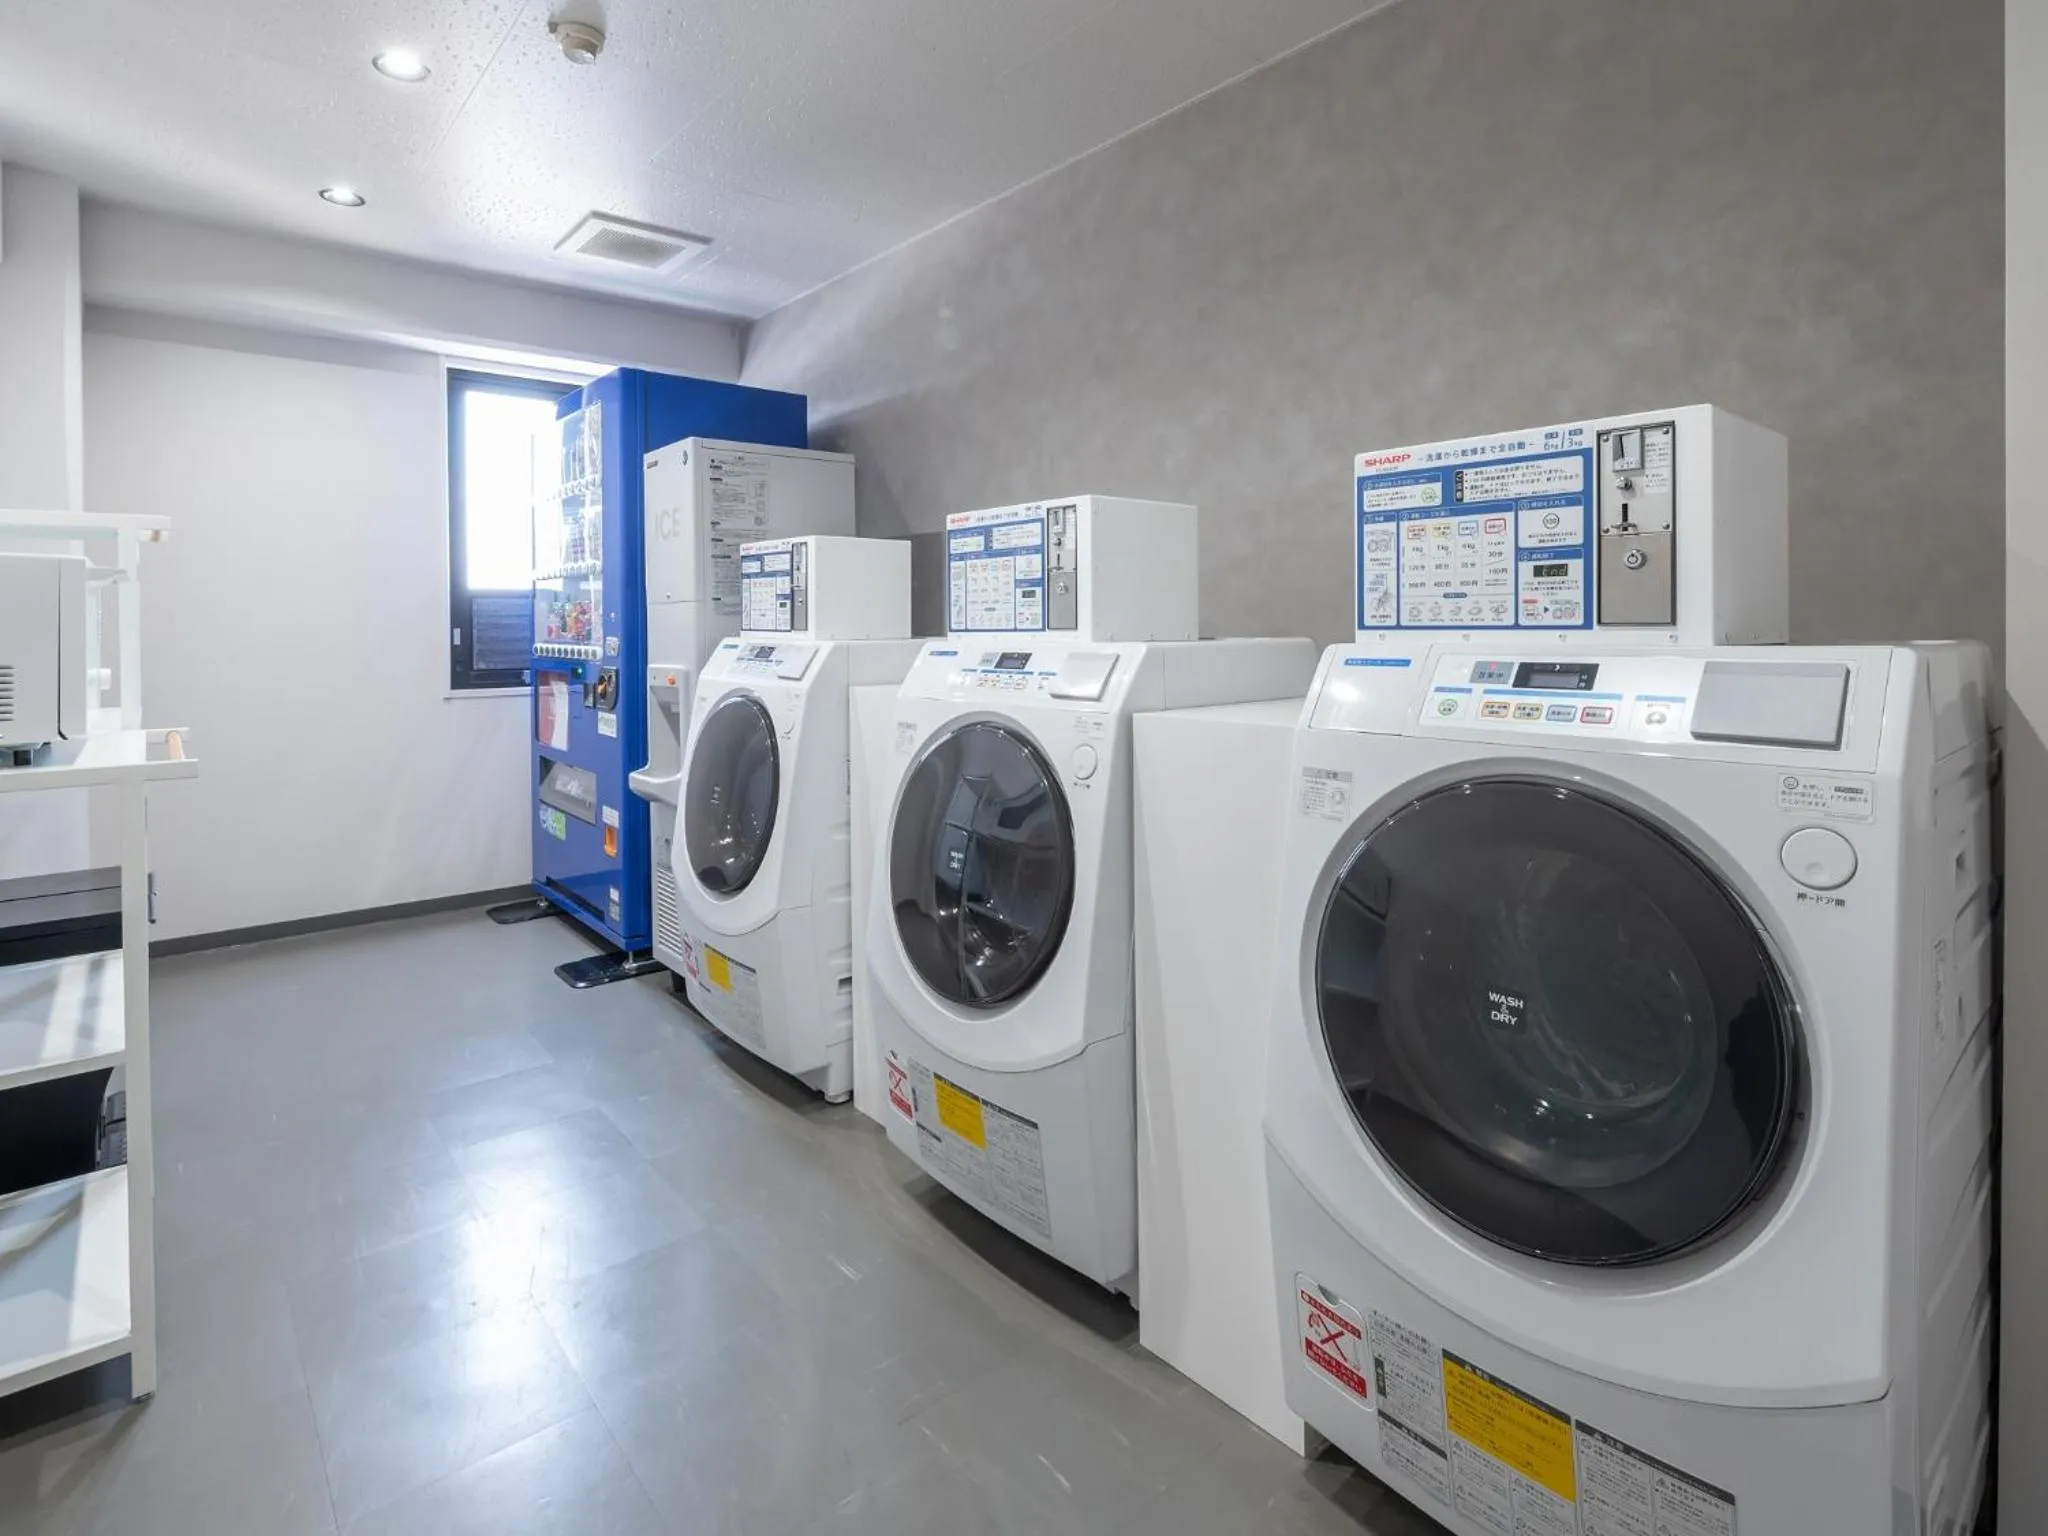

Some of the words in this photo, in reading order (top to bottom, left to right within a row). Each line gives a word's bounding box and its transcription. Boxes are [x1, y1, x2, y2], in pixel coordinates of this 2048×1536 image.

[1365, 454, 1412, 468] SHARP
[655, 506, 680, 541] ICE
[1489, 990, 1523, 1009] WASH
[1491, 1010, 1518, 1025] DRY
